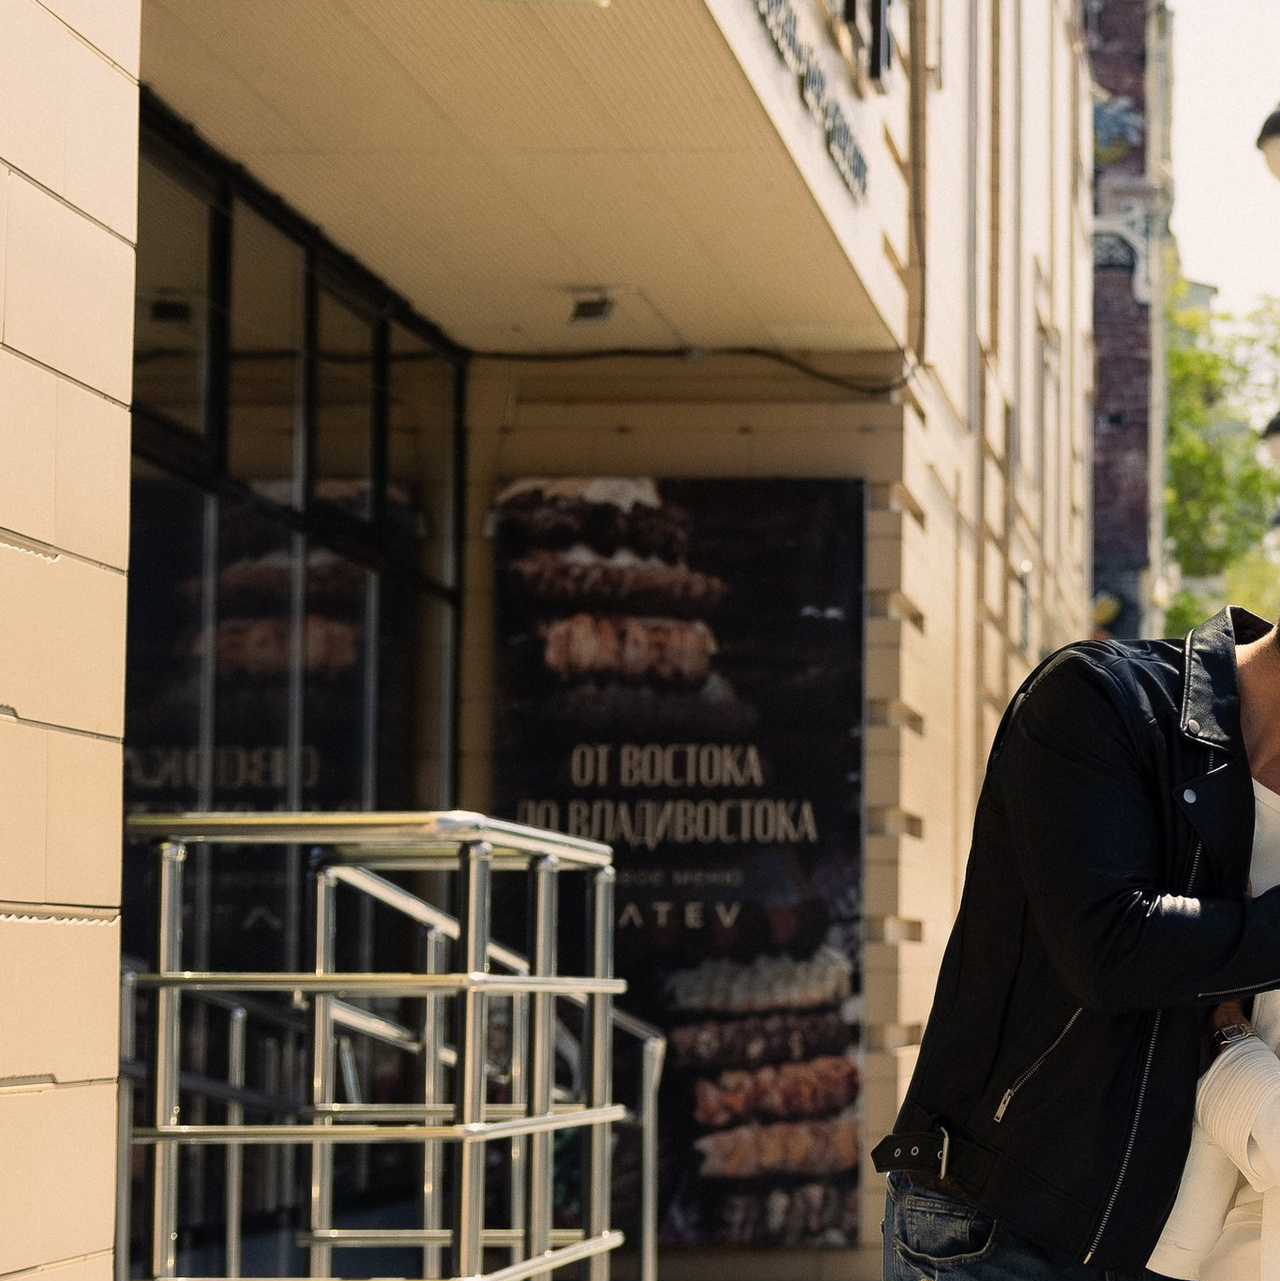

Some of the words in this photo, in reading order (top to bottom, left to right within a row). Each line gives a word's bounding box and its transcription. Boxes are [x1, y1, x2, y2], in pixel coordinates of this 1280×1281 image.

[571, 743, 612, 788] ОТ
[620, 743, 764, 788] ВОСТОКА
[567, 799, 818, 848] ВЛАДИВОСТОКА
[615, 900, 742, 928] ATEV
